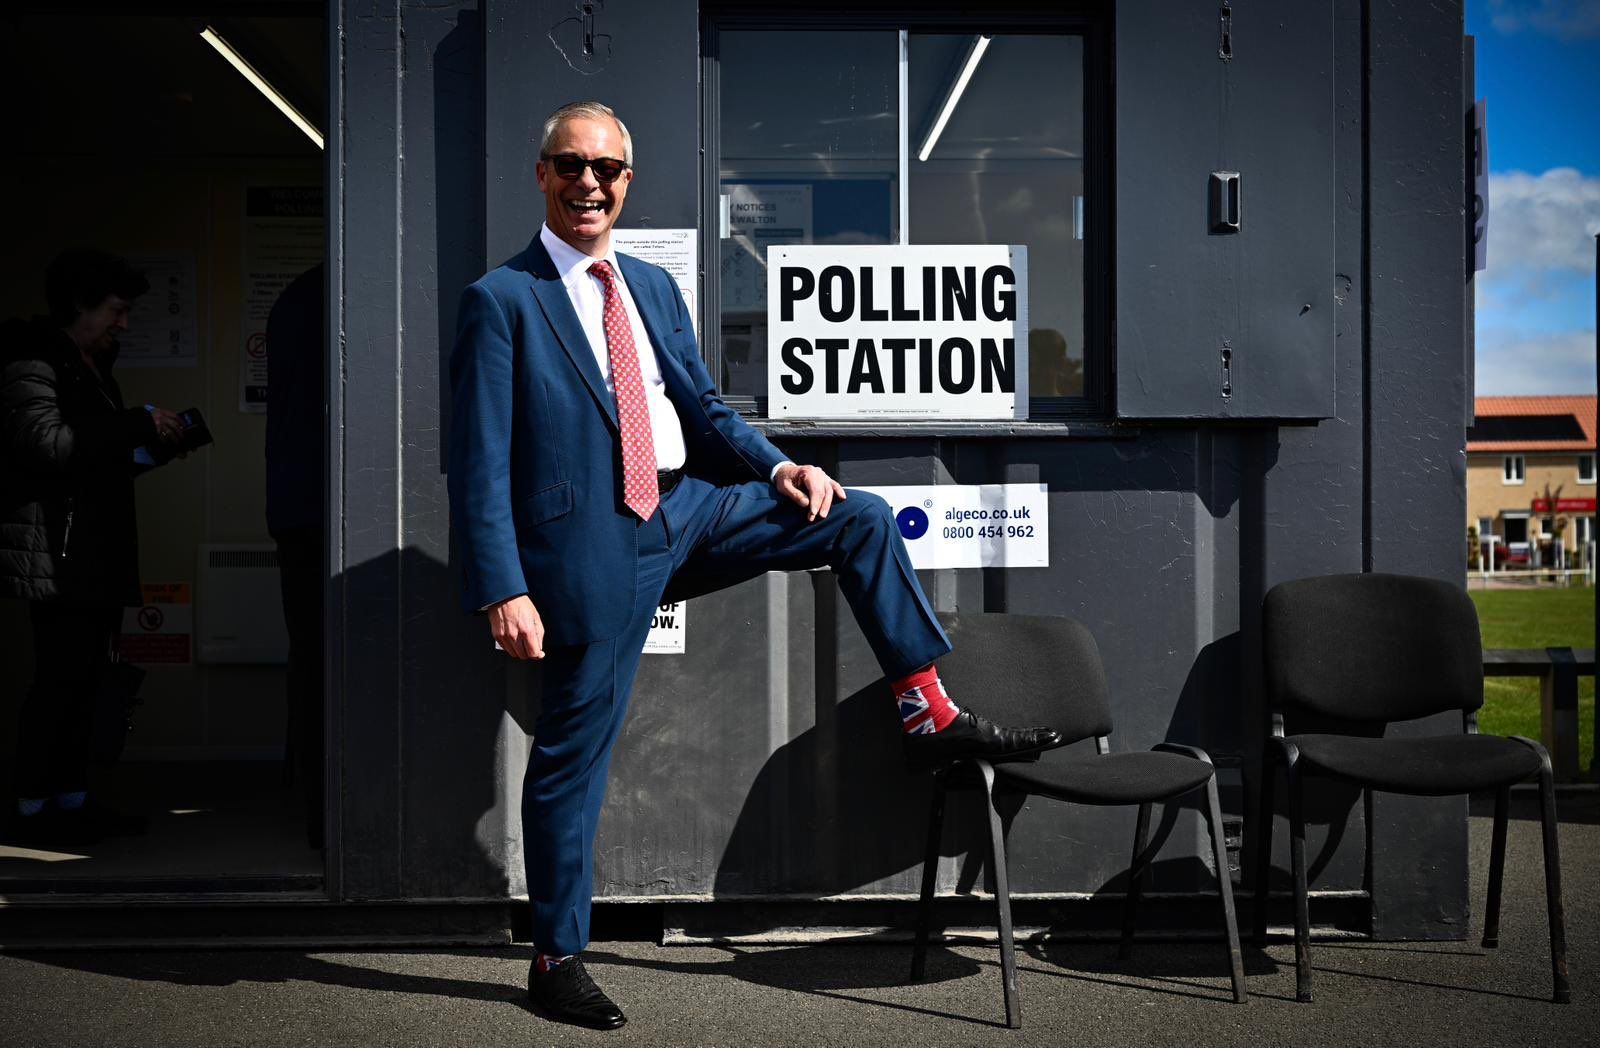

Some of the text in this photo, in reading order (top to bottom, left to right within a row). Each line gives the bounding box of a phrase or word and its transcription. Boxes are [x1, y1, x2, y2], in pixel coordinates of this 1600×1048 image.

[736, 203, 776, 212] NOTICES
[736, 215, 776, 224] WALTON
[780, 265, 1017, 323] POLLING
[780, 336, 1016, 395] STATION
[945, 505, 1031, 523] algeco.co.uk
[943, 525, 1034, 539] 0800 454 962
[650, 616, 679, 629] OW.
